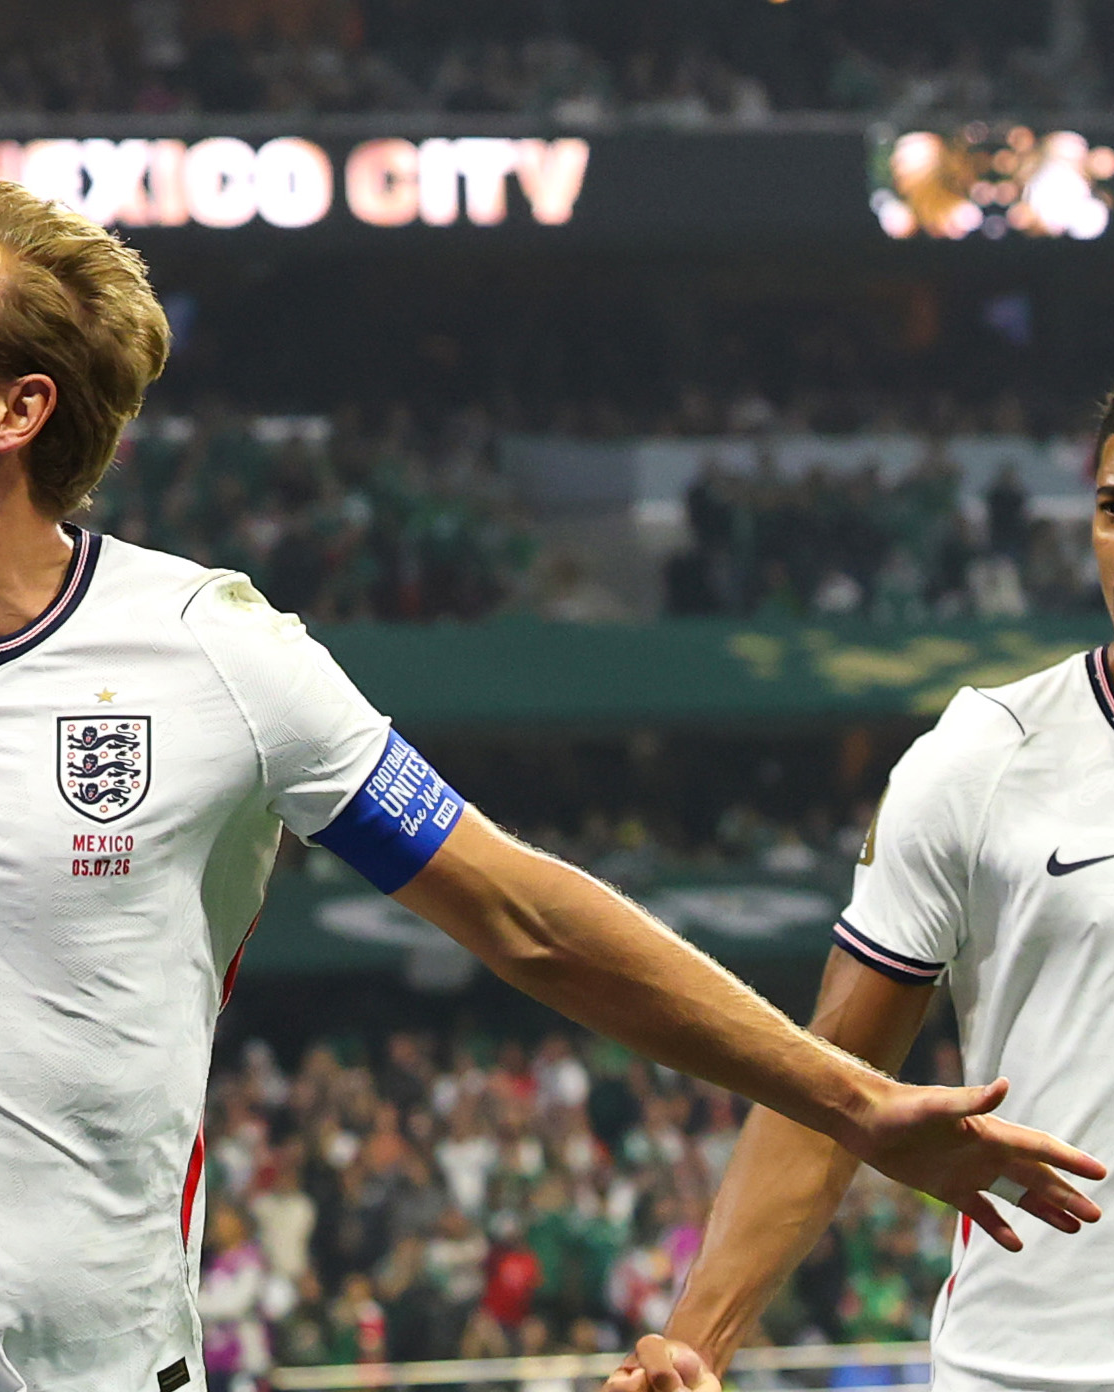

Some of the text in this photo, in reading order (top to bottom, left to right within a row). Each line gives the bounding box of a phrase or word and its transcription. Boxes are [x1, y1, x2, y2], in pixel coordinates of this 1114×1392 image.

[344, 138, 588, 227] CITY
[365, 740, 409, 801] FOOTBALL
[379, 752, 429, 818] UNITES
[73, 835, 134, 852] MEXICO
[399, 808, 427, 837] the
[72, 859, 130, 876] 05.07.26
